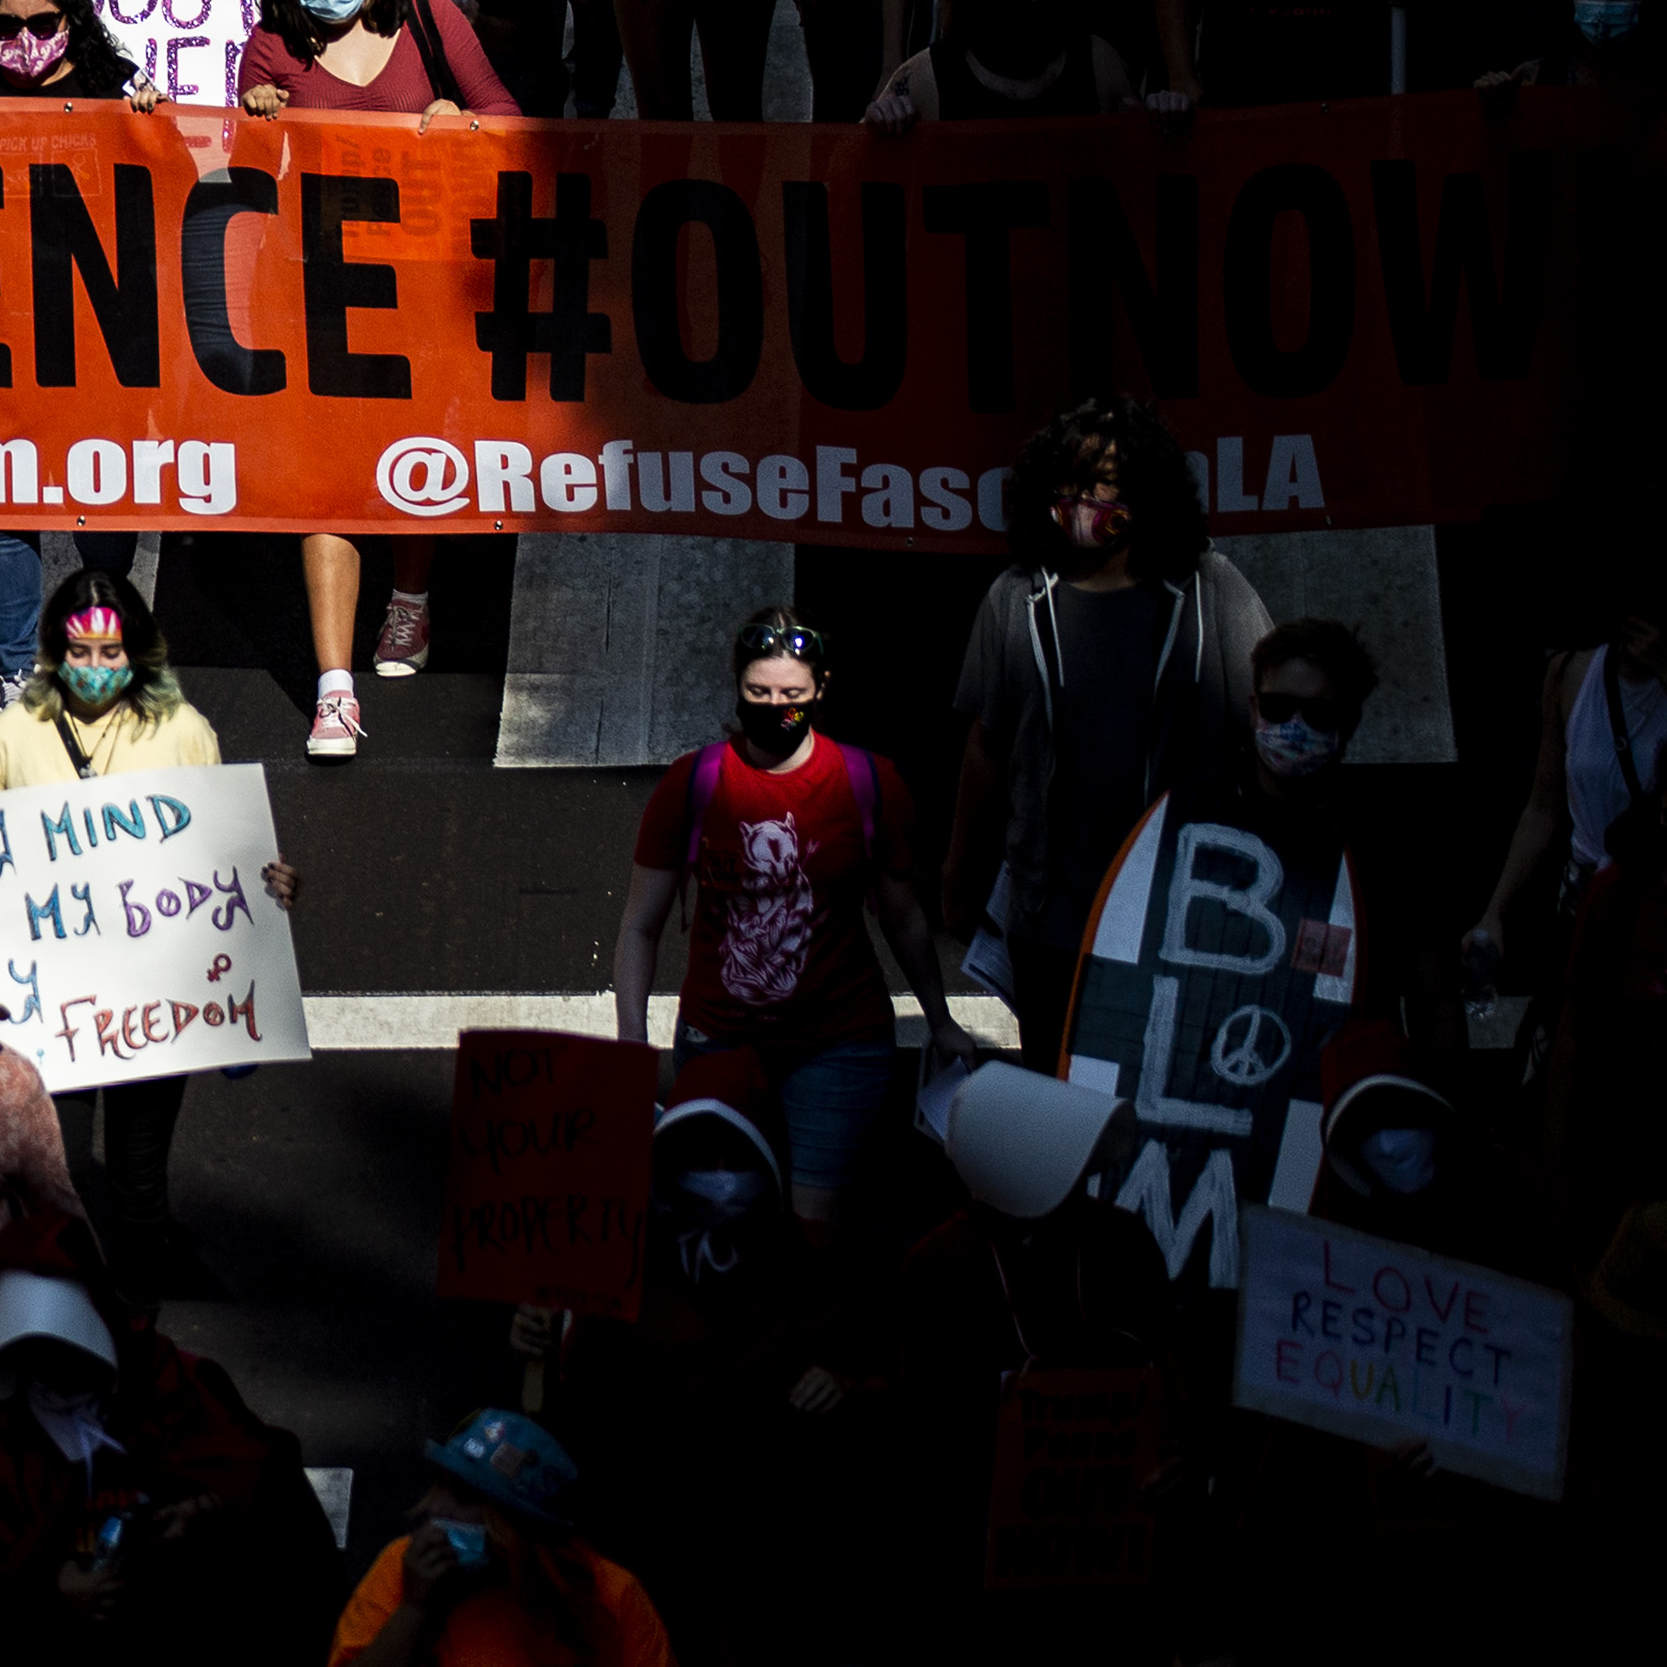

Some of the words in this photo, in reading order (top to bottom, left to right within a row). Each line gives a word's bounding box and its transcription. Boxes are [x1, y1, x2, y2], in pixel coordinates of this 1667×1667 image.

[1323, 1239, 1490, 1335] LOVE
[1292, 1291, 1512, 1384] RESPECT
[1274, 1339, 1527, 1441] EQUALITY
